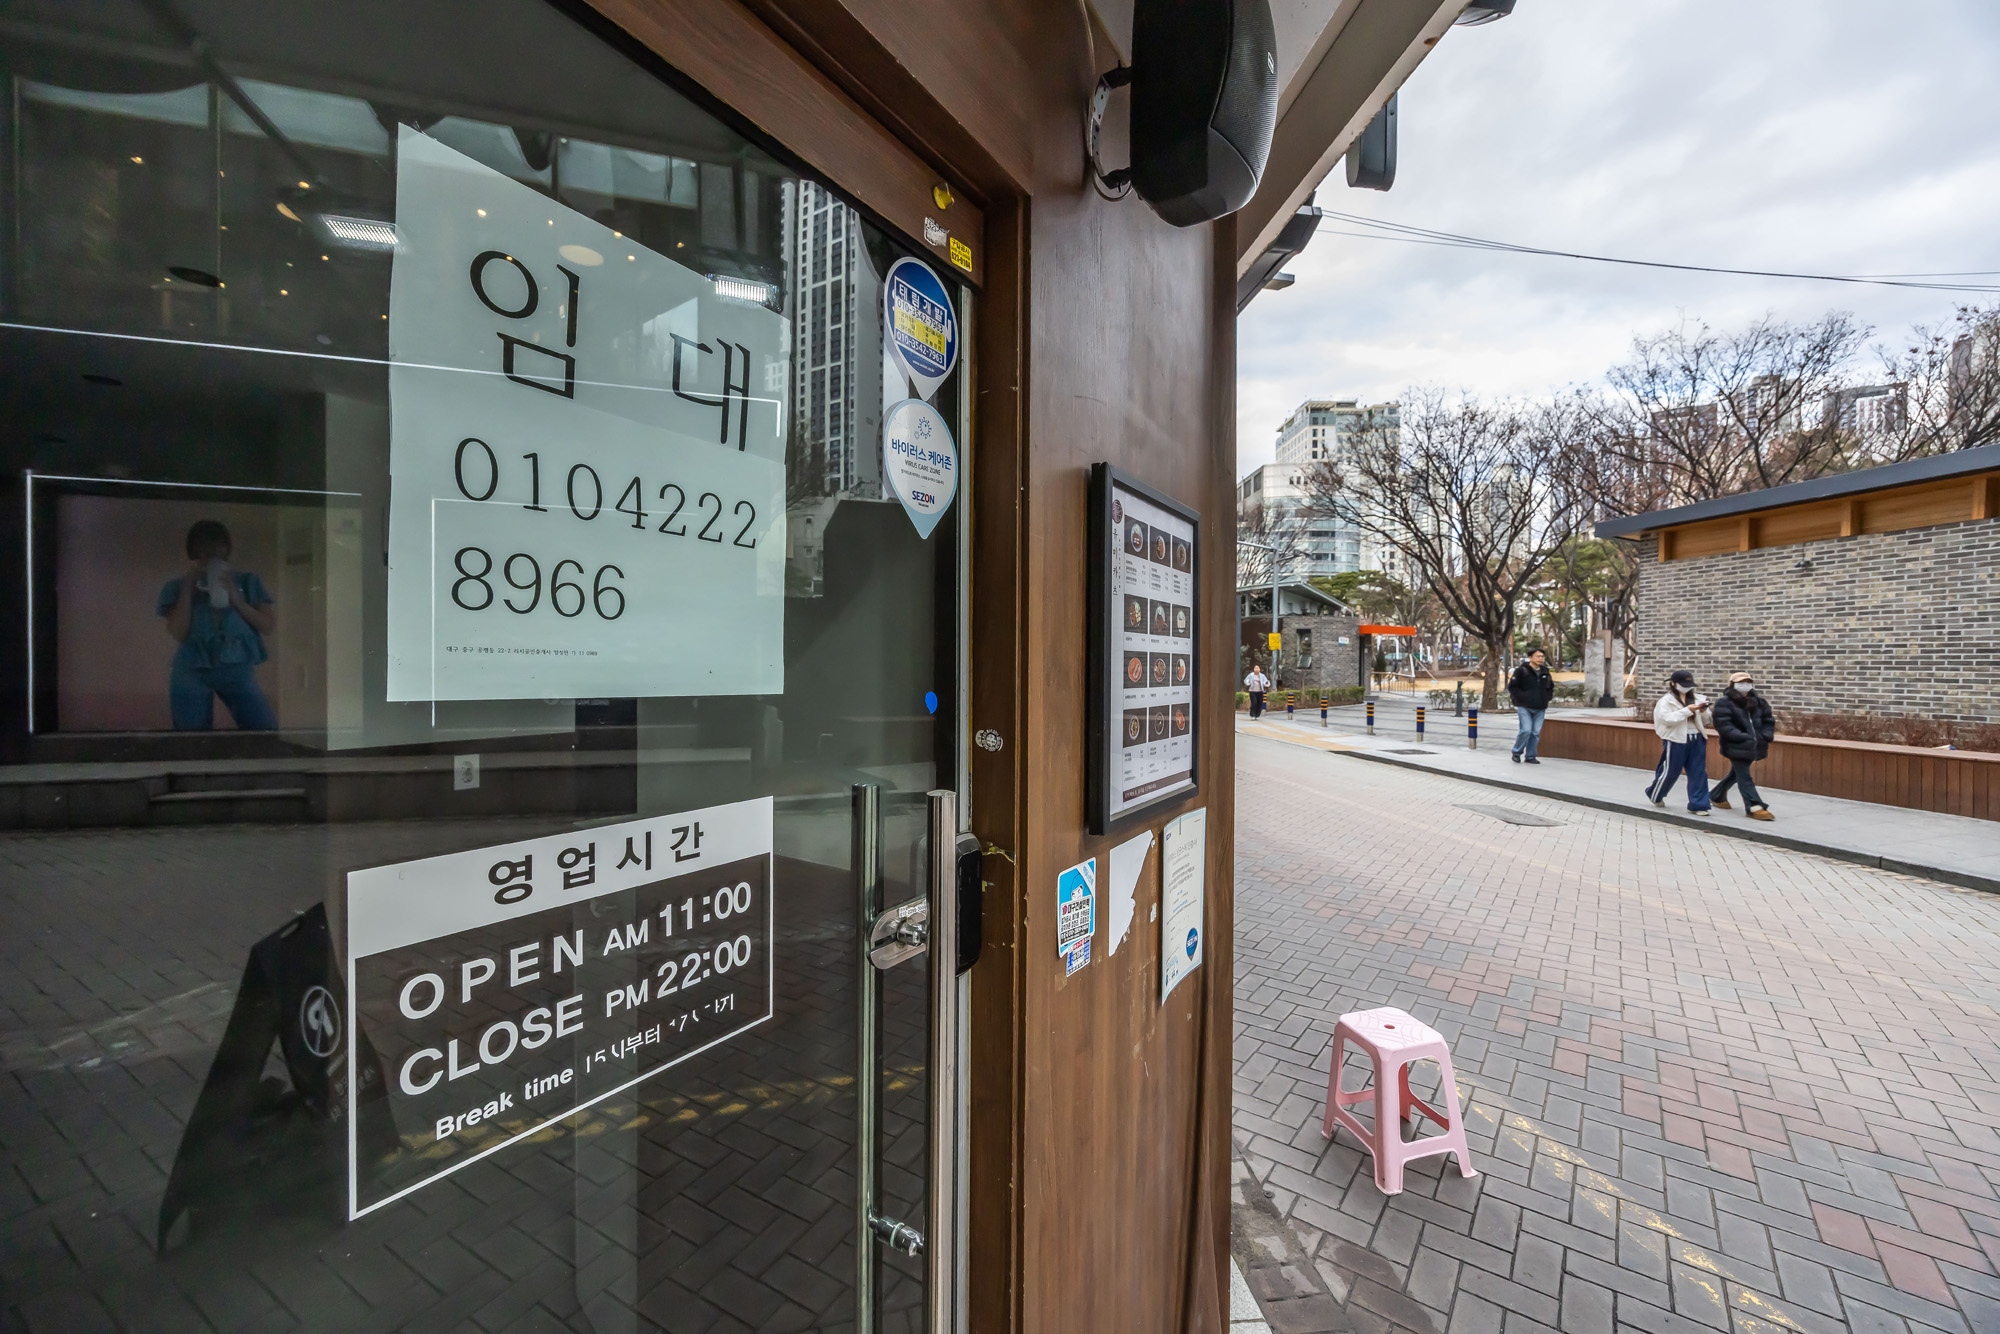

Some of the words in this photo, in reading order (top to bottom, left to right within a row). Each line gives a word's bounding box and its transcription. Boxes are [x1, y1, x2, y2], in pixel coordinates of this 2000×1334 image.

[469, 250, 580, 399] 임
[669, 332, 751, 451] 대
[454, 437, 757, 549] 0104222
[891, 438, 927, 462] 바이러스
[928, 450, 953, 471] 케어존
[905, 459, 918, 469] VIRUS
[918, 463, 929, 473] CARE
[912, 490, 935, 505] SEZON
[450, 546, 626, 620] 8966
[488, 822, 704, 905] 영업시간
[399, 929, 584, 1020] OPEN
[603, 919, 649, 956] AM
[659, 882, 752, 937] 11:00
[399, 994, 584, 1096] CLOSE
[606, 979, 649, 1017] PM
[656, 935, 752, 998] 22:00
[435, 1091, 514, 1140] Break
[524, 1066, 574, 1100] time
